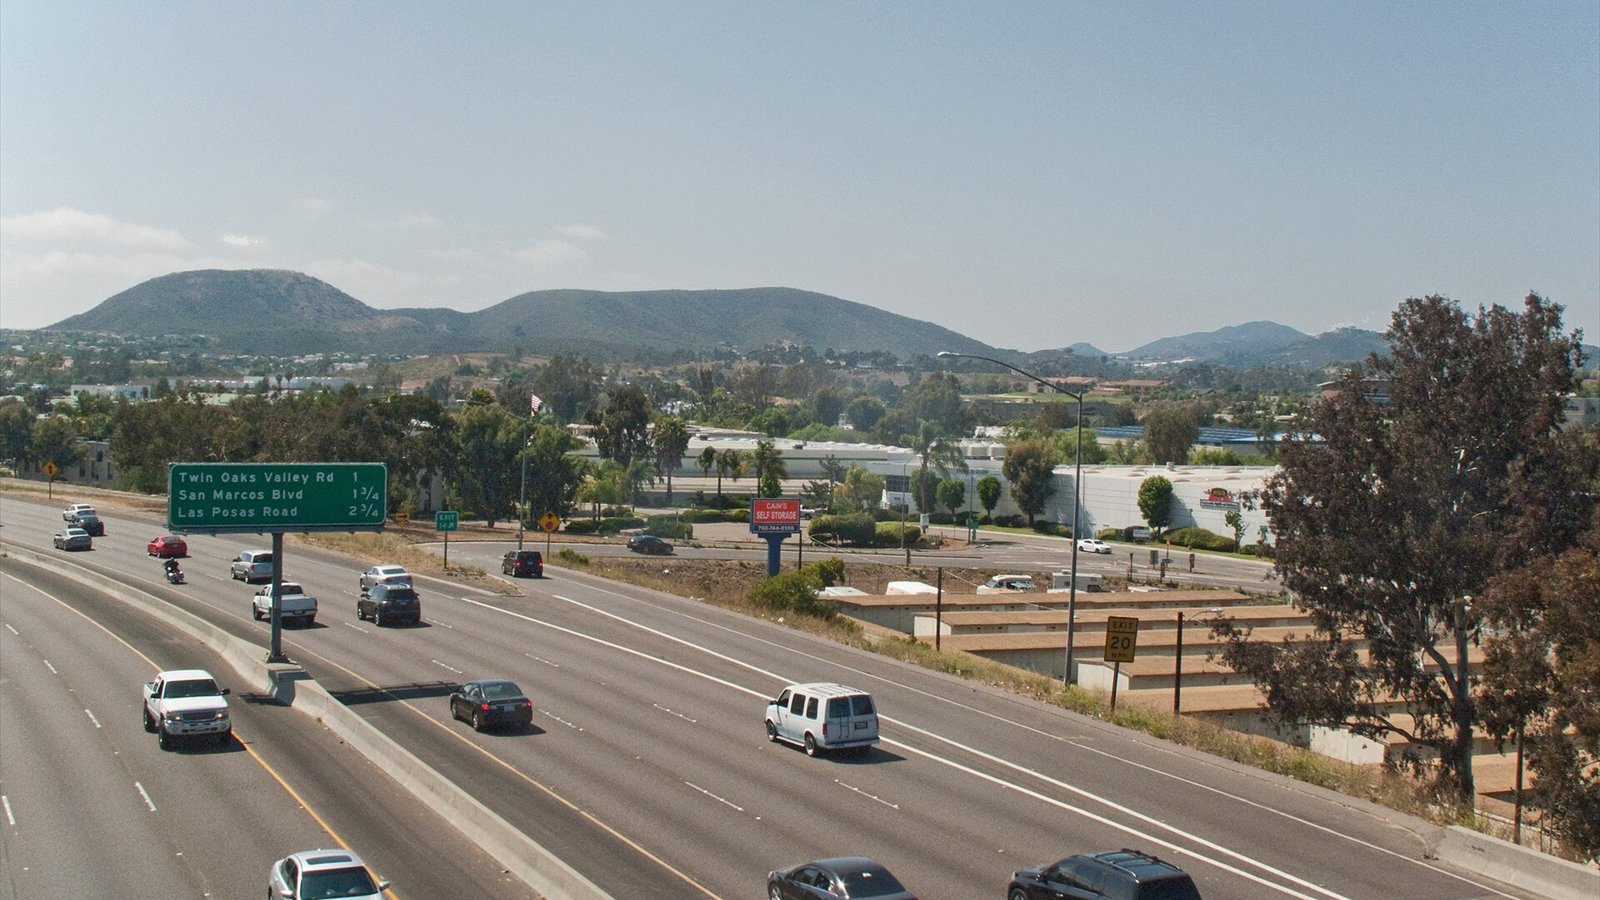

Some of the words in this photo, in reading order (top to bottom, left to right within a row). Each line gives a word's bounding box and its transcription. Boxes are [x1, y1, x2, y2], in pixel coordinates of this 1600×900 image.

[179, 472, 213, 483] Twin
[221, 472, 256, 483] Oaks
[264, 472, 309, 485] Valley
[316, 472, 334, 482] Rd
[353, 472, 358, 482] 1
[178, 489, 206, 500] San
[213, 489, 265, 500] Marcos
[272, 489, 303, 500] Blvd
[766, 502, 788, 510] CAIN'S
[178, 507, 204, 518] Las
[212, 507, 255, 517] Posas
[263, 506, 298, 517] Road
[756, 511, 770, 520] SELF
[770, 511, 797, 520] STORAGE
[1112, 621, 1134, 629] EXIT
[1110, 636, 1131, 650] 20
